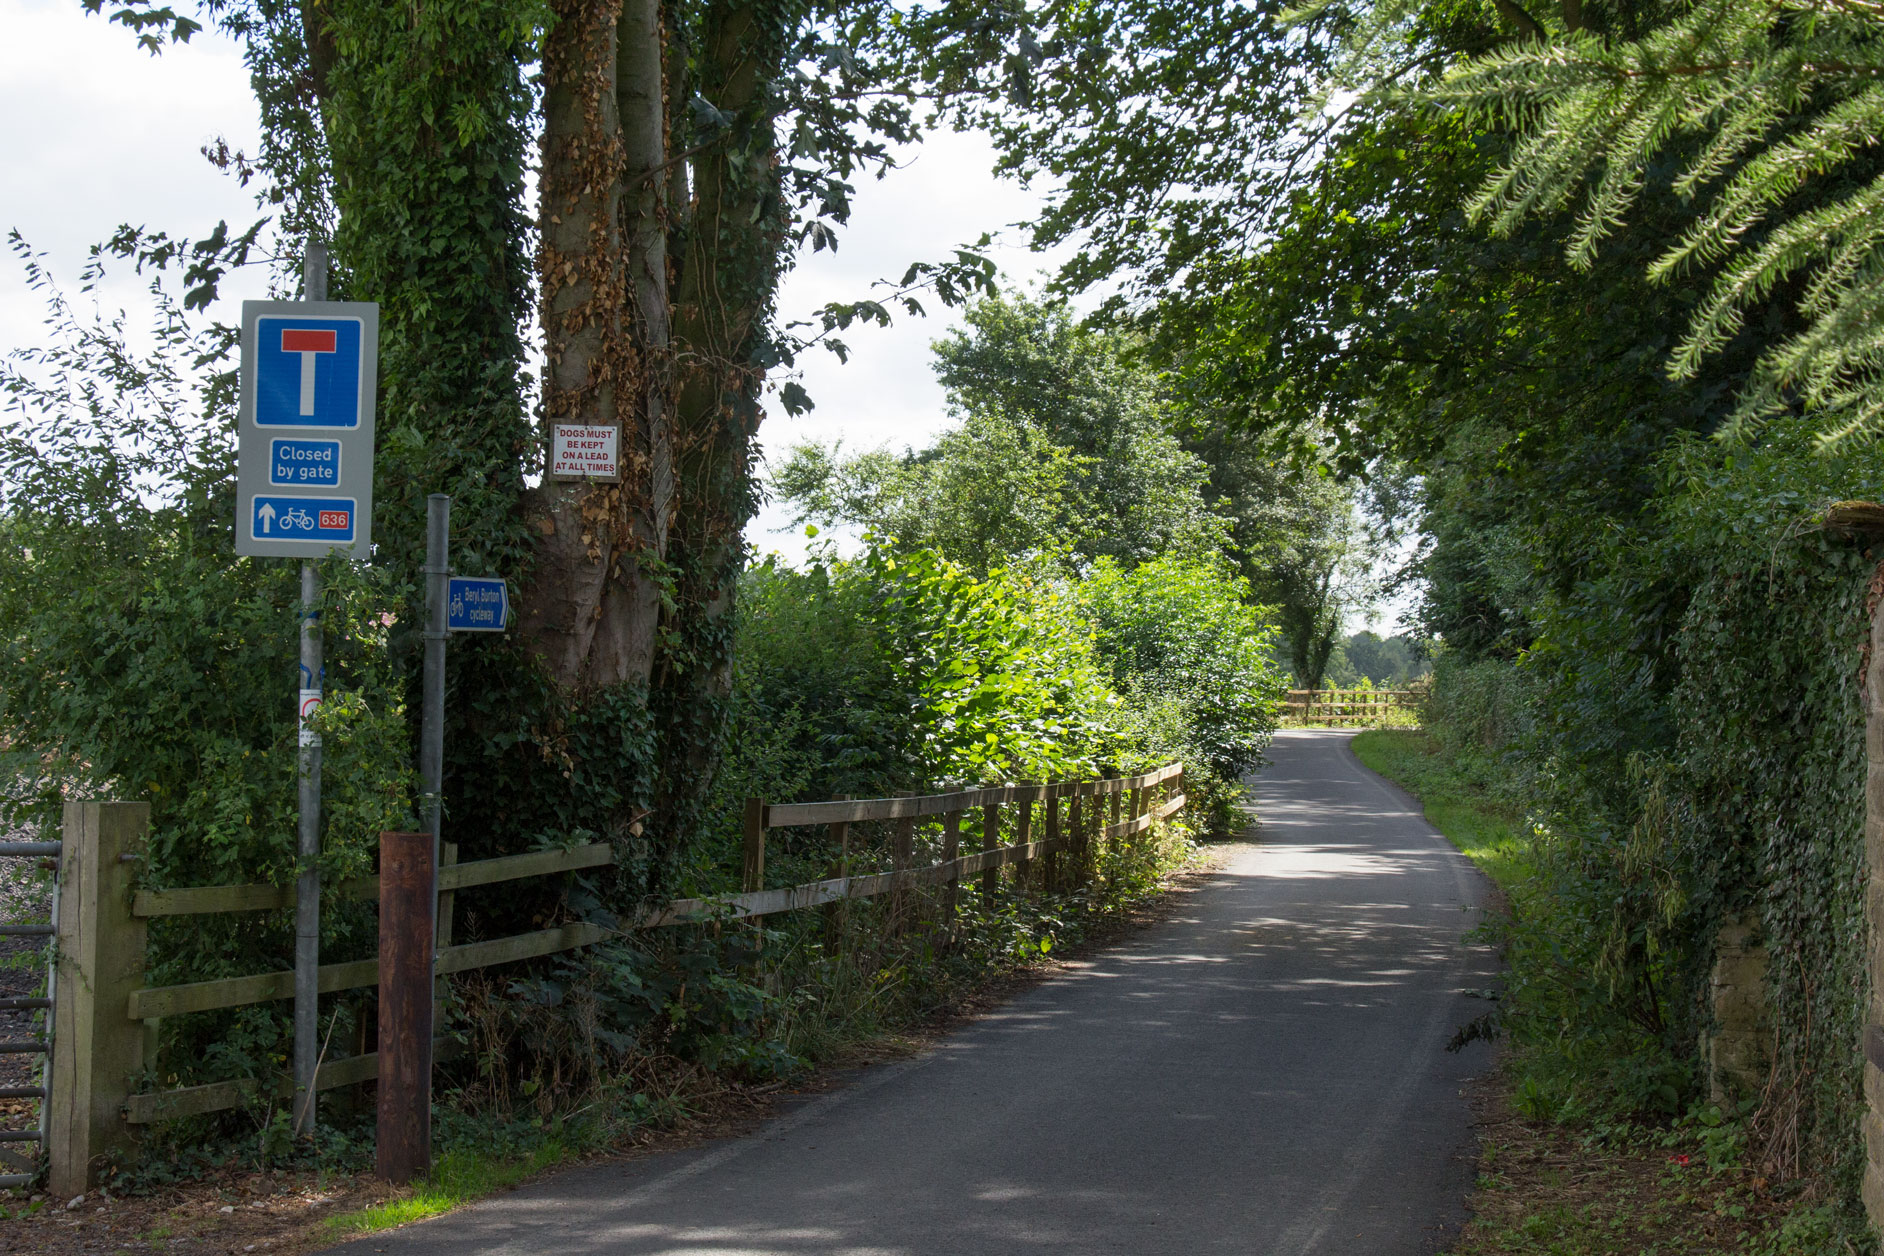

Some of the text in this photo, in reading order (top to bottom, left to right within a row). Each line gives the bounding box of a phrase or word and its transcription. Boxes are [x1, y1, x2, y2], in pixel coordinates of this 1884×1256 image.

[560, 429, 612, 438] DOGS MUST
[567, 440, 604, 449] BE KEPT
[280, 446, 332, 461] Closed
[562, 451, 608, 460] ON A LEAD
[277, 464, 333, 480] by gate
[555, 462, 614, 472] AT ALL TIMES
[321, 514, 346, 526] 636
[465, 586, 500, 605] Beryl Burton
[470, 606, 494, 624] cycleway
